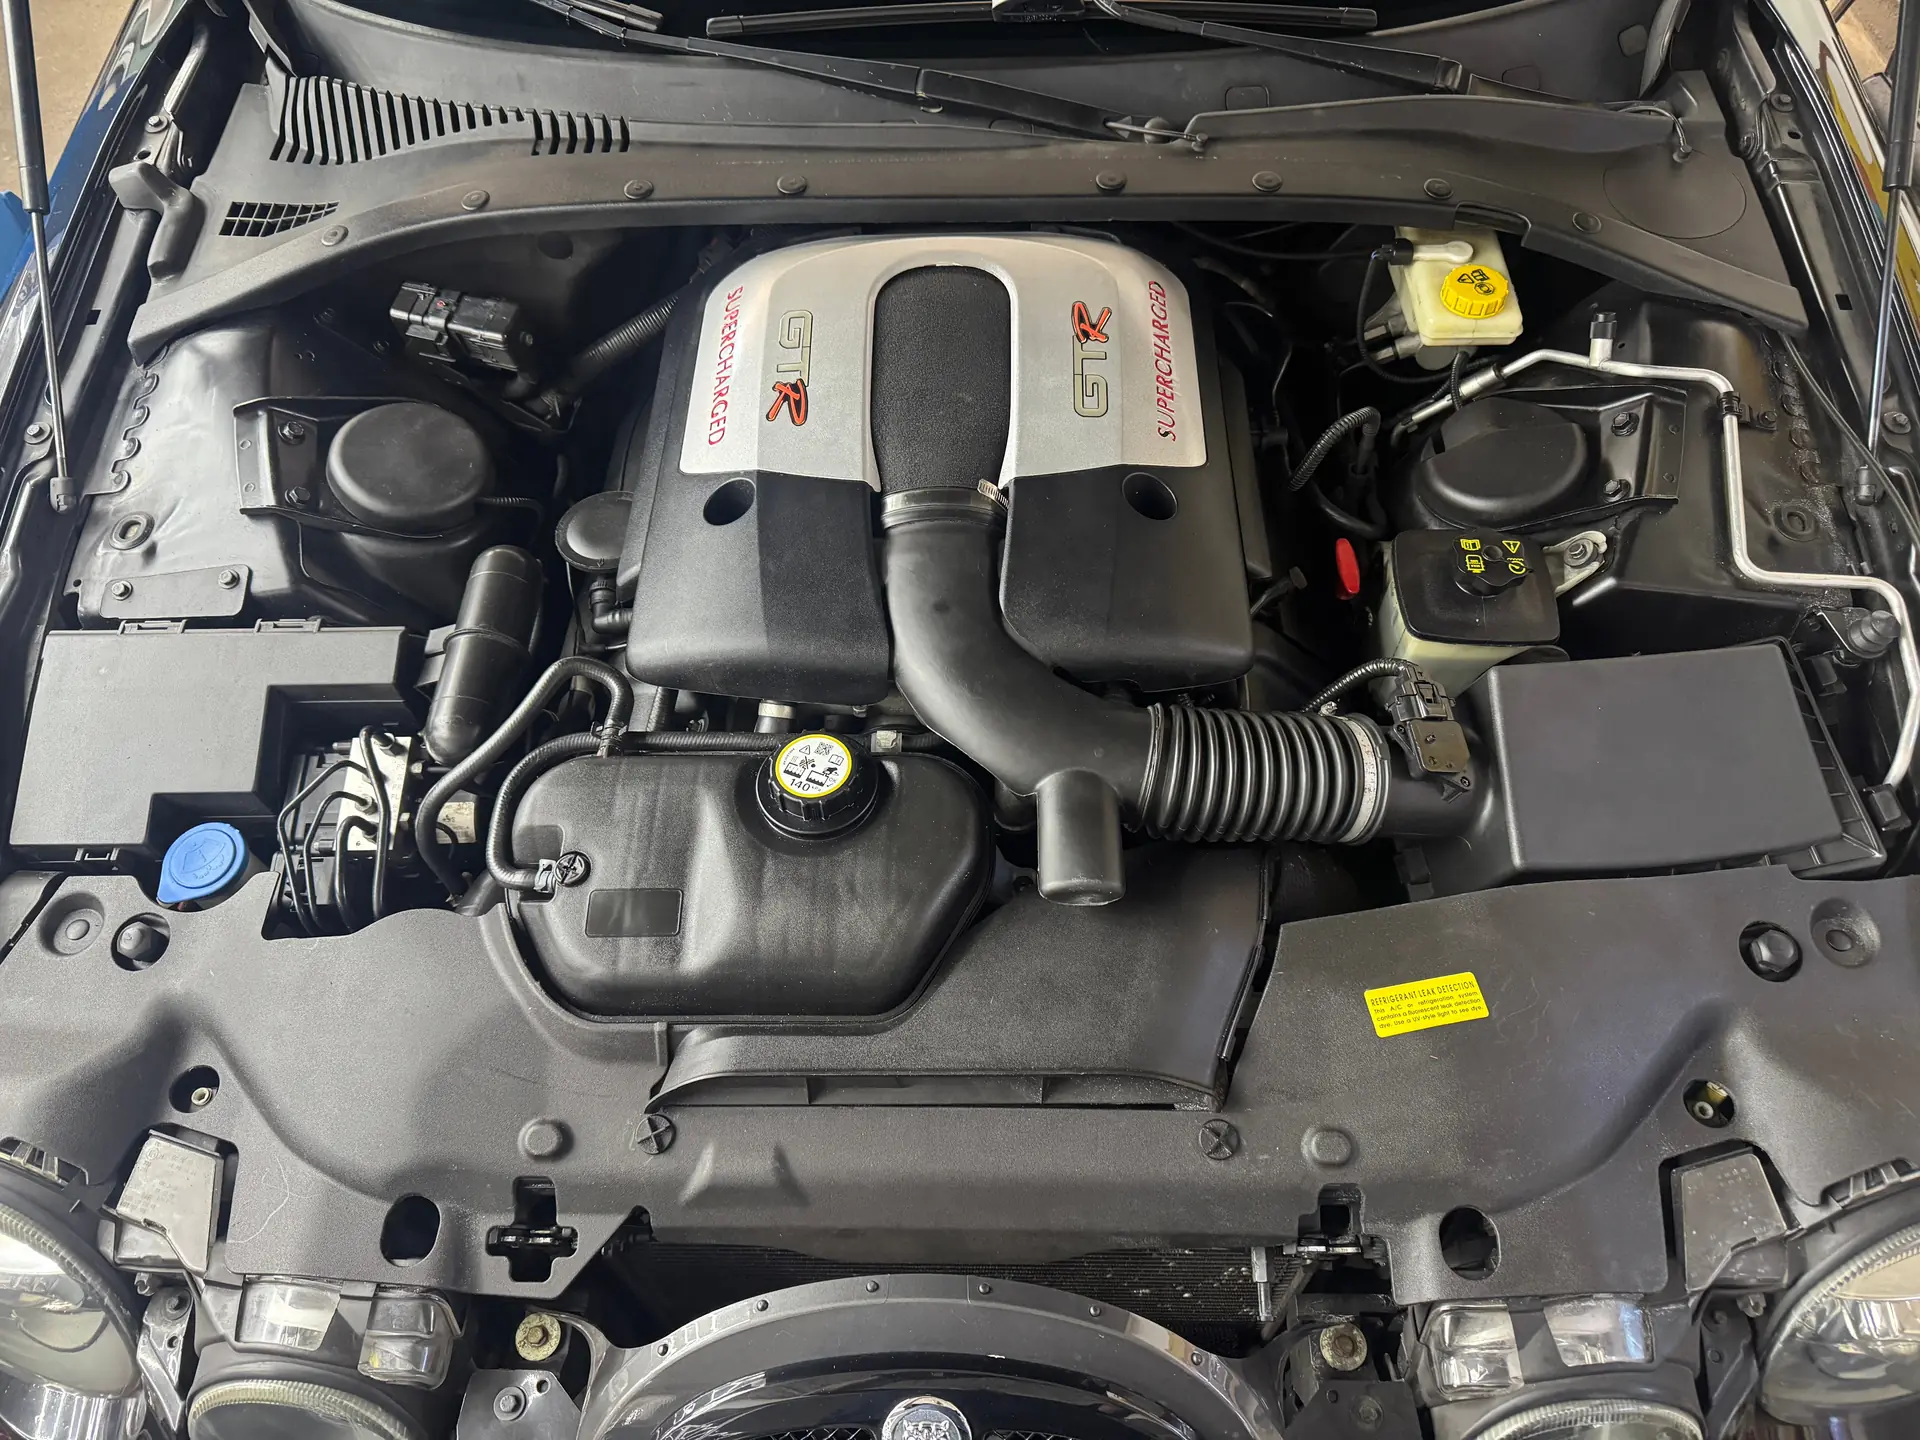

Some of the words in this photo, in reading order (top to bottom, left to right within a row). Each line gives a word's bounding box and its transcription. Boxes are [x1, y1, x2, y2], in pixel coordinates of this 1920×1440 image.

[708, 285, 744, 446] SUPERCHARGED
[1148, 280, 1177, 442] SUPERCHARGED
[790, 778, 811, 792] 140
[1370, 990, 1417, 1006] REFRIGERANT
[1417, 987, 1437, 998] LEAK
[1437, 981, 1475, 994] DETECTION
[1418, 995, 1454, 1006] refrigeration
[1377, 1012, 1402, 1022] contains
[1454, 998, 1481, 1007] detection
[1412, 1012, 1436, 1022] UV-style
[1437, 1009, 1451, 1018] light
